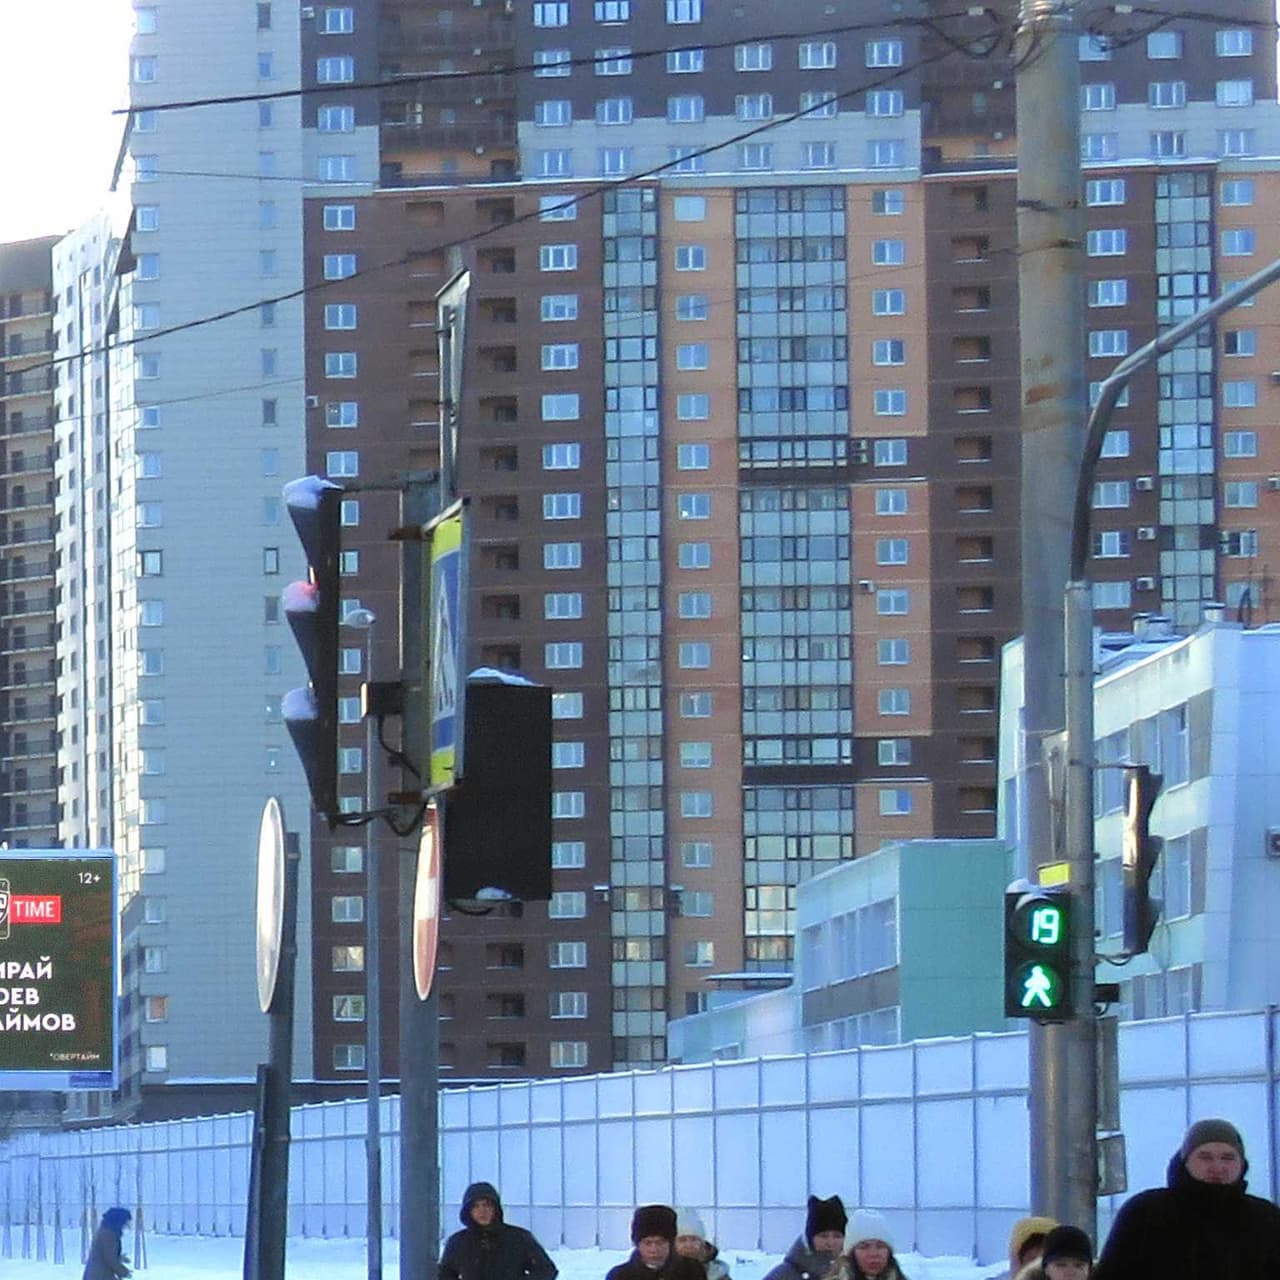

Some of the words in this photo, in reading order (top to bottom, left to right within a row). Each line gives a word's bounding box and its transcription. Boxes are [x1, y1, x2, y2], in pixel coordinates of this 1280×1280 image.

[78, 872, 101, 884] 12+
[14, 900, 54, 918] TIME
[1032, 908, 1060, 944] 19
